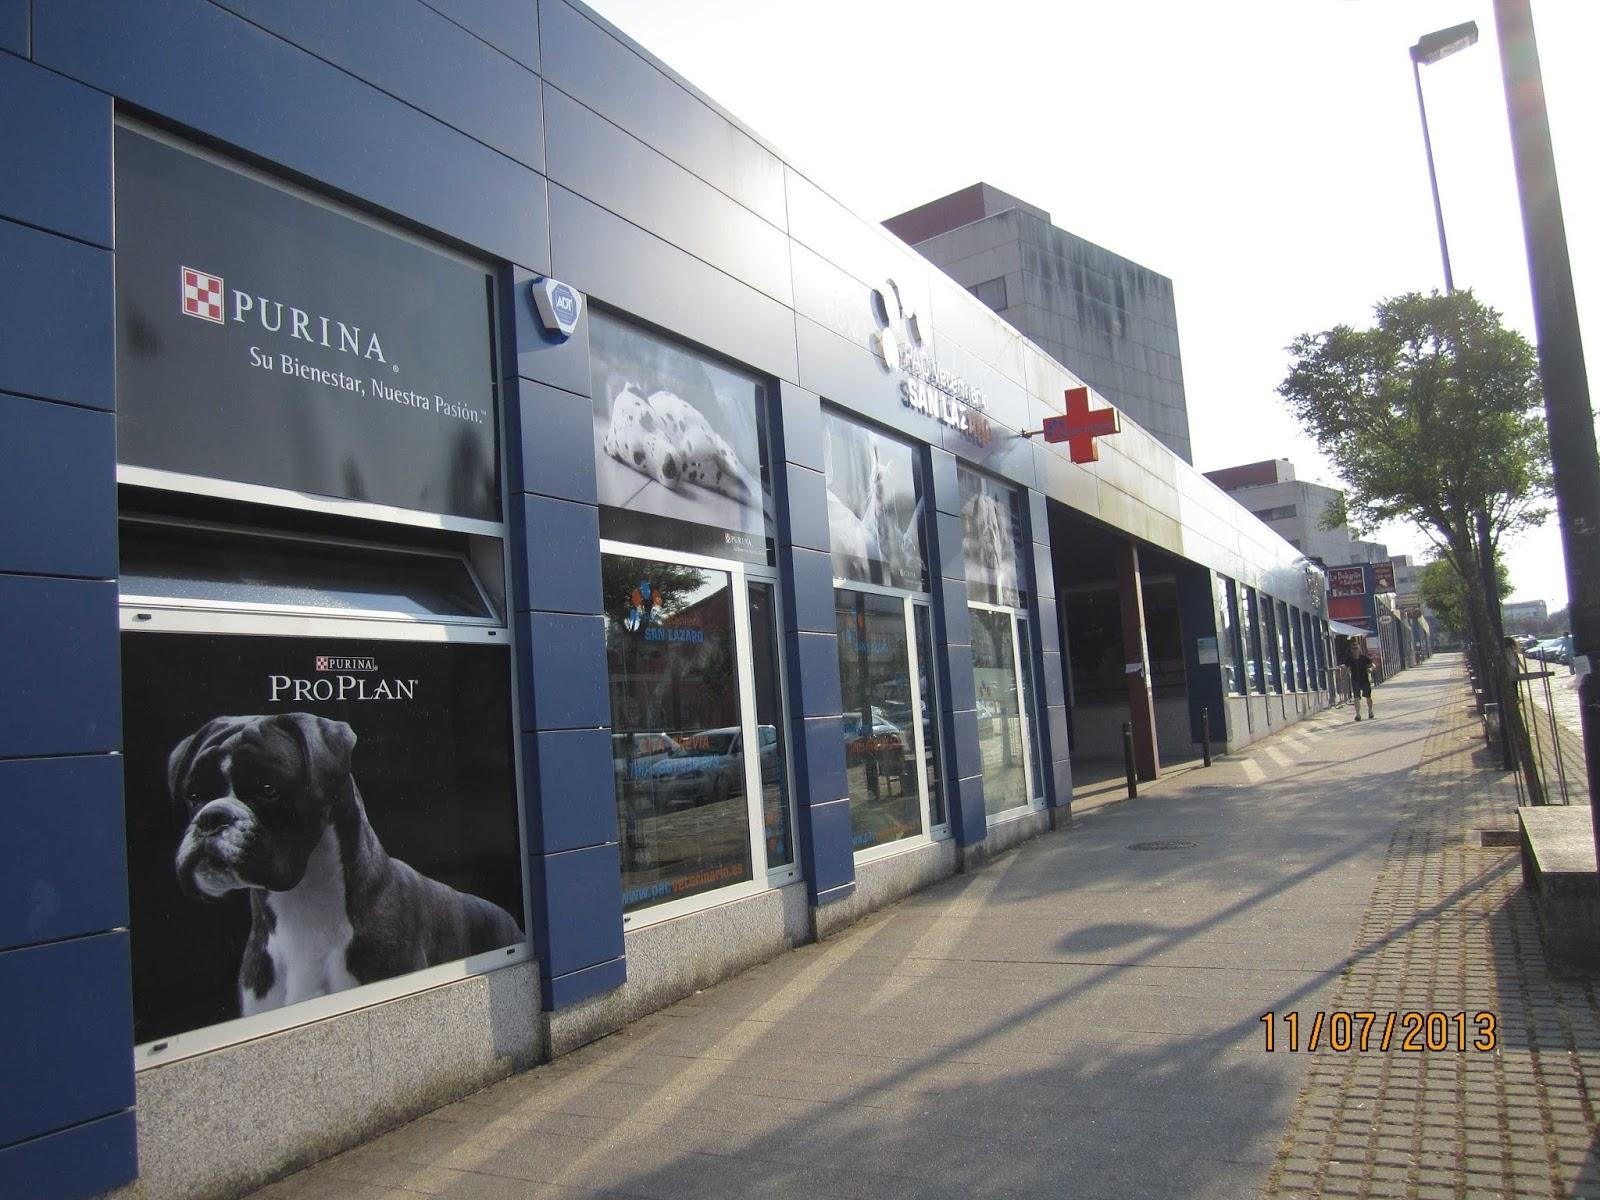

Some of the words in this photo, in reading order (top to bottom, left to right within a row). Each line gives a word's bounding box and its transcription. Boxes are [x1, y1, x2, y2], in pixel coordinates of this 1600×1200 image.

[556, 296, 573, 312] ADT
[231, 289, 387, 364] PURINA
[249, 346, 273, 371] Su
[280, 354, 366, 397] Bienestar,
[371, 378, 430, 411] Nuestra
[907, 377, 940, 418] SAN
[328, 658, 373, 670] PURINA
